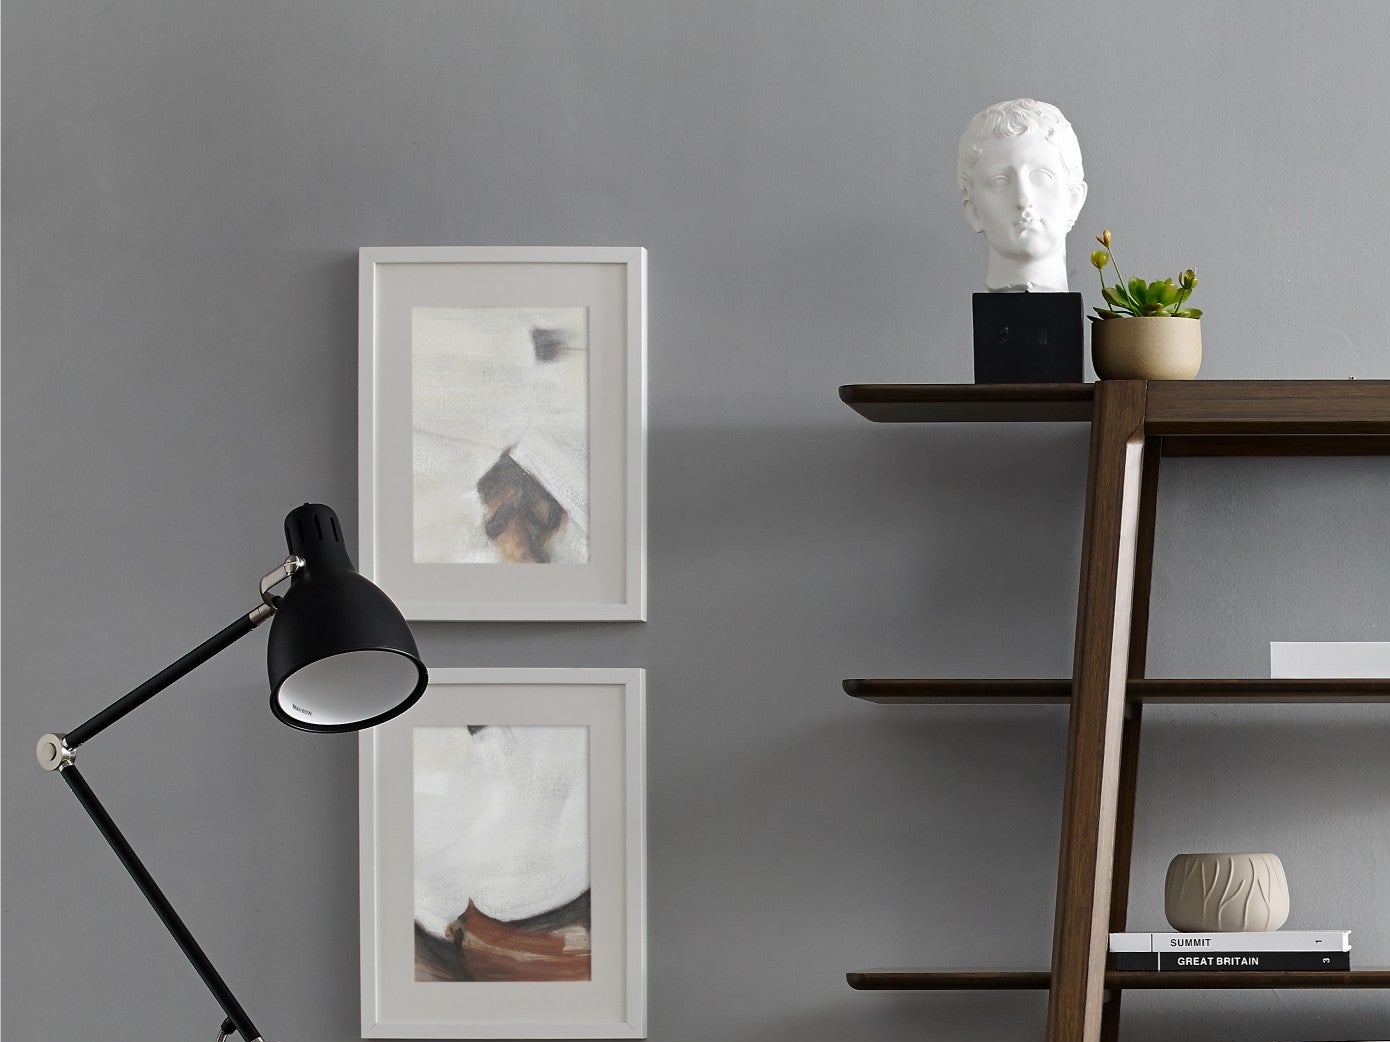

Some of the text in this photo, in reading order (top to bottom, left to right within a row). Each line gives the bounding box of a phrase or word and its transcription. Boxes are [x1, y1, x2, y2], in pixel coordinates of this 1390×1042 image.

[1170, 938, 1212, 947] SUMMIT
[1177, 956, 1259, 966] GREAT BRITAIN
